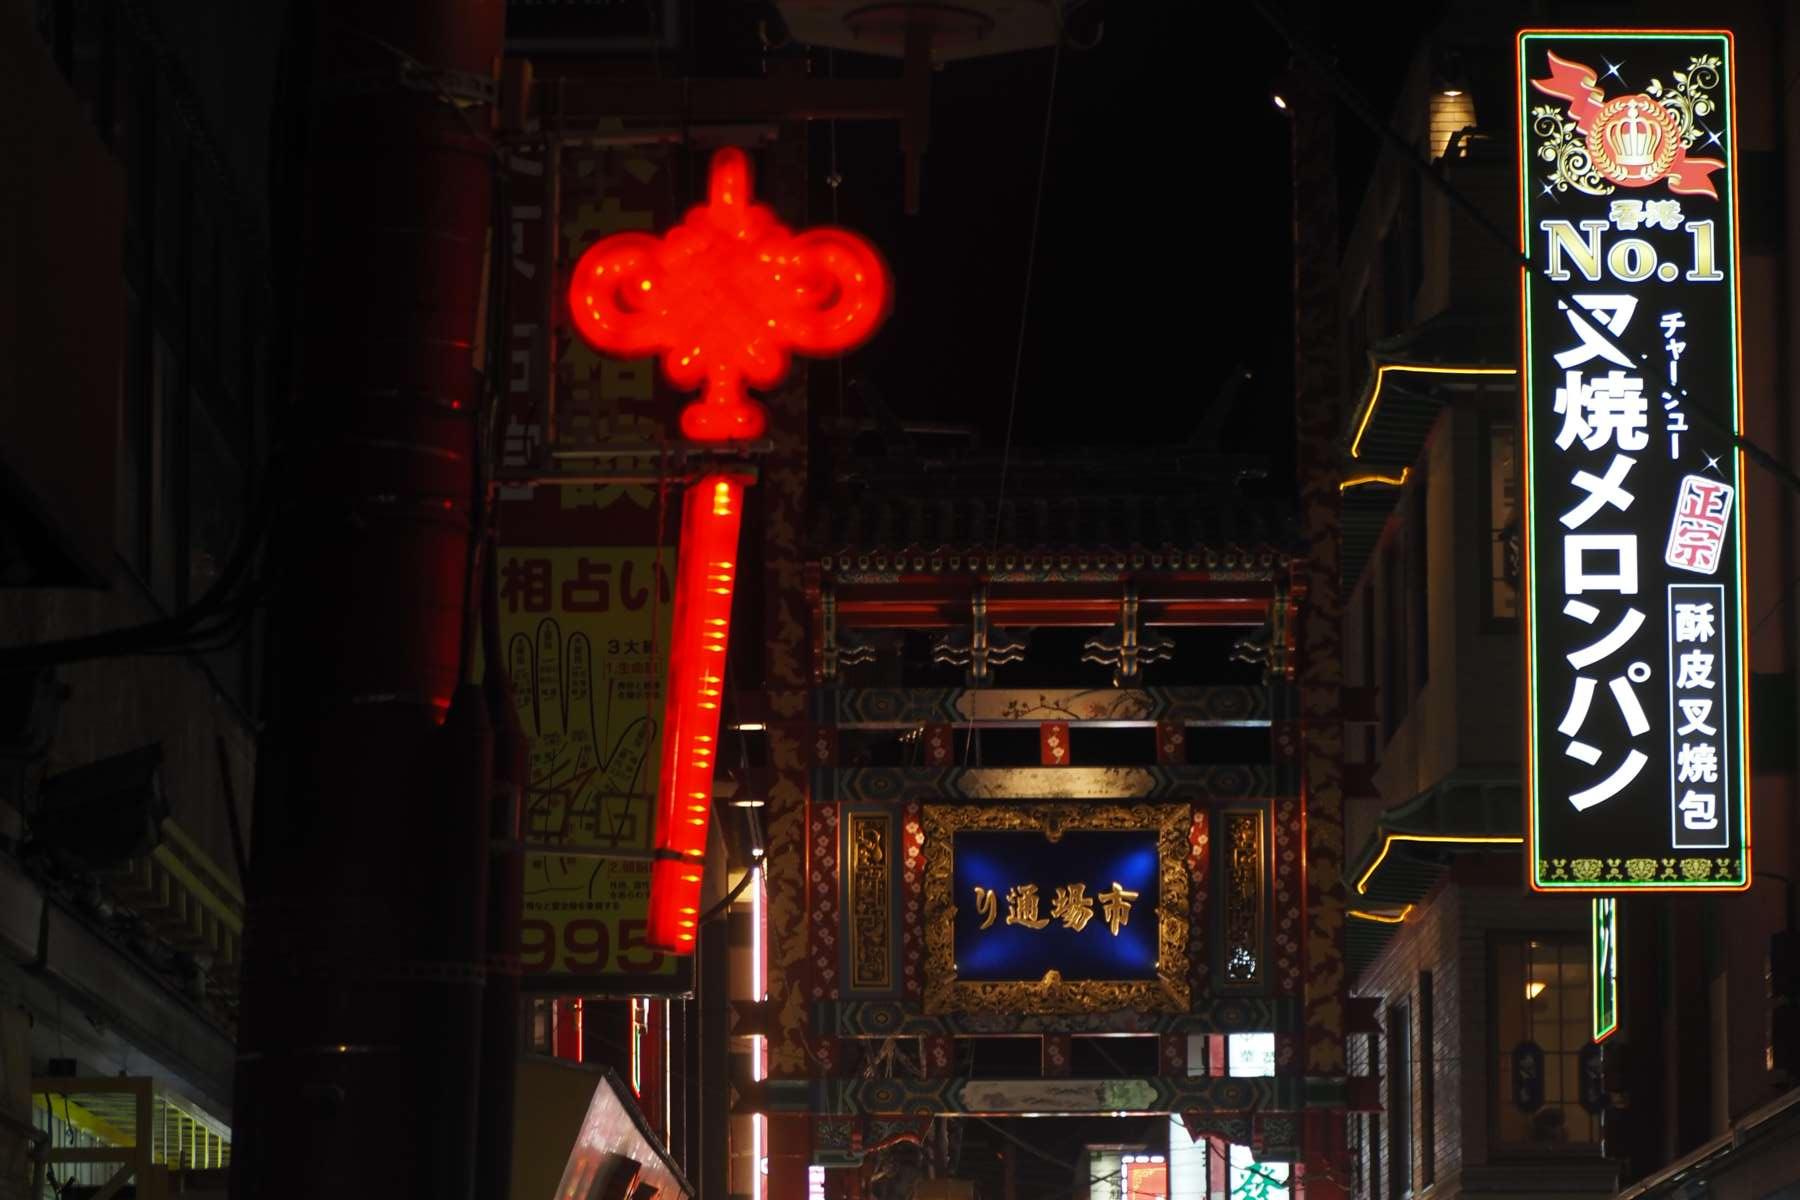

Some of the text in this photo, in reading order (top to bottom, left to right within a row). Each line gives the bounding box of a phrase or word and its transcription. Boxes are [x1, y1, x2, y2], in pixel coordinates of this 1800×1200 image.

[1541, 219, 1724, 282] No.1
[1609, 200, 1685, 231] 香港
[1660, 312, 1689, 459] チャーシュー
[1553, 294, 1652, 812] 叉焼メロンパン
[1674, 484, 1732, 567] 正宗
